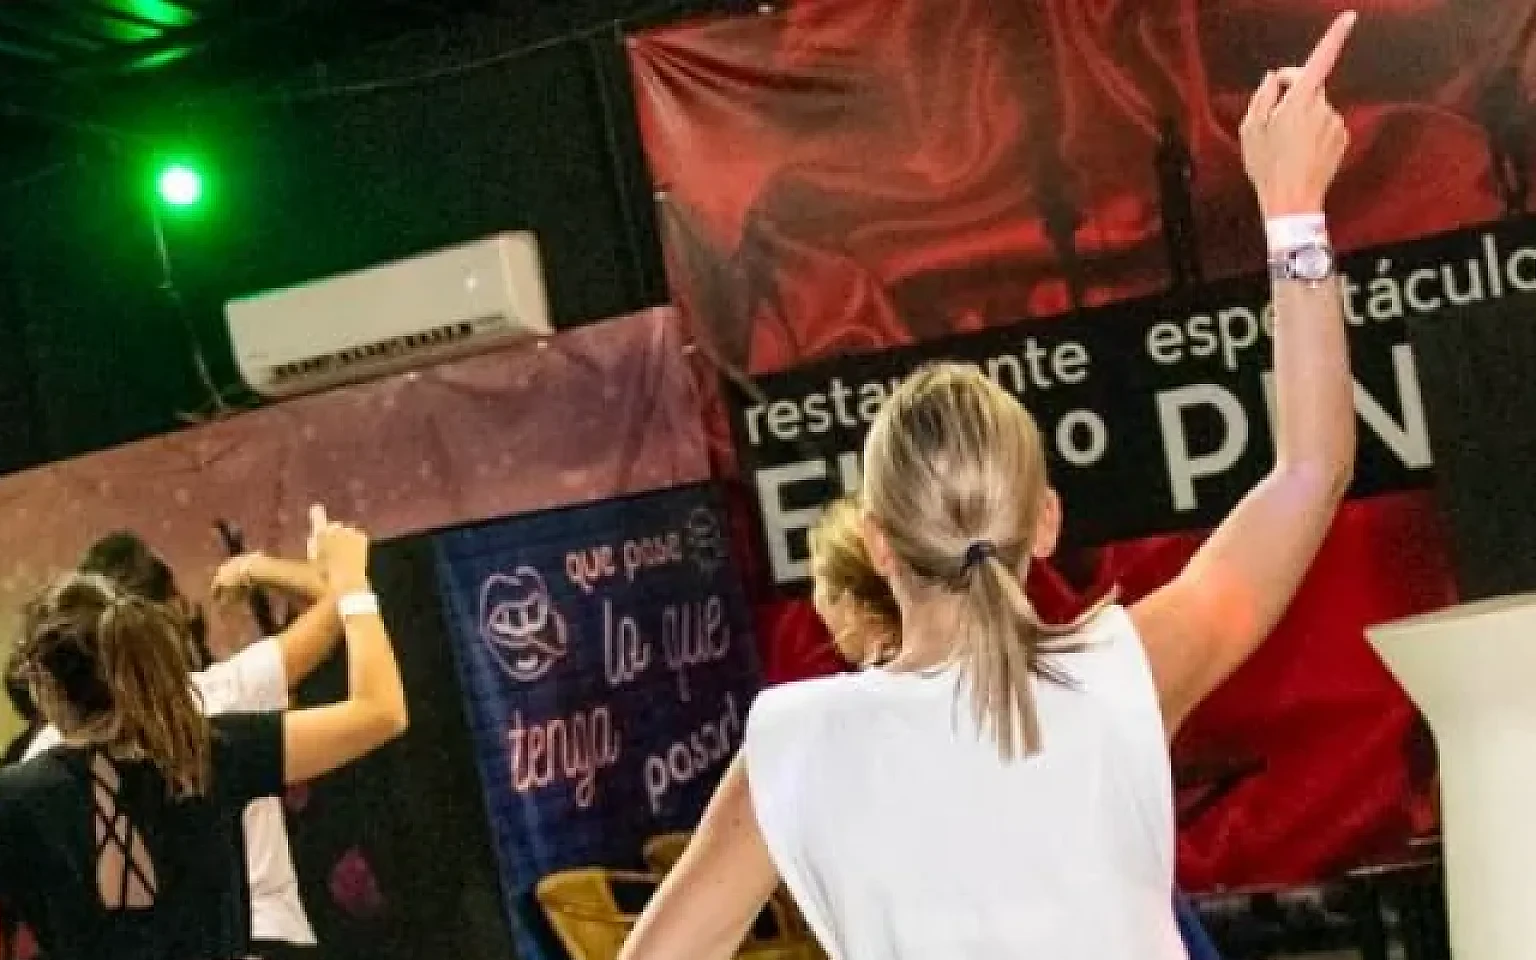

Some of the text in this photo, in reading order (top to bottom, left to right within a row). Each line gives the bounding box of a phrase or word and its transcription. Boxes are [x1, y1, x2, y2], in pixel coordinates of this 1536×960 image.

[744, 336, 1092, 446] restante
[565, 545, 615, 594] que
[663, 595, 731, 702] que
